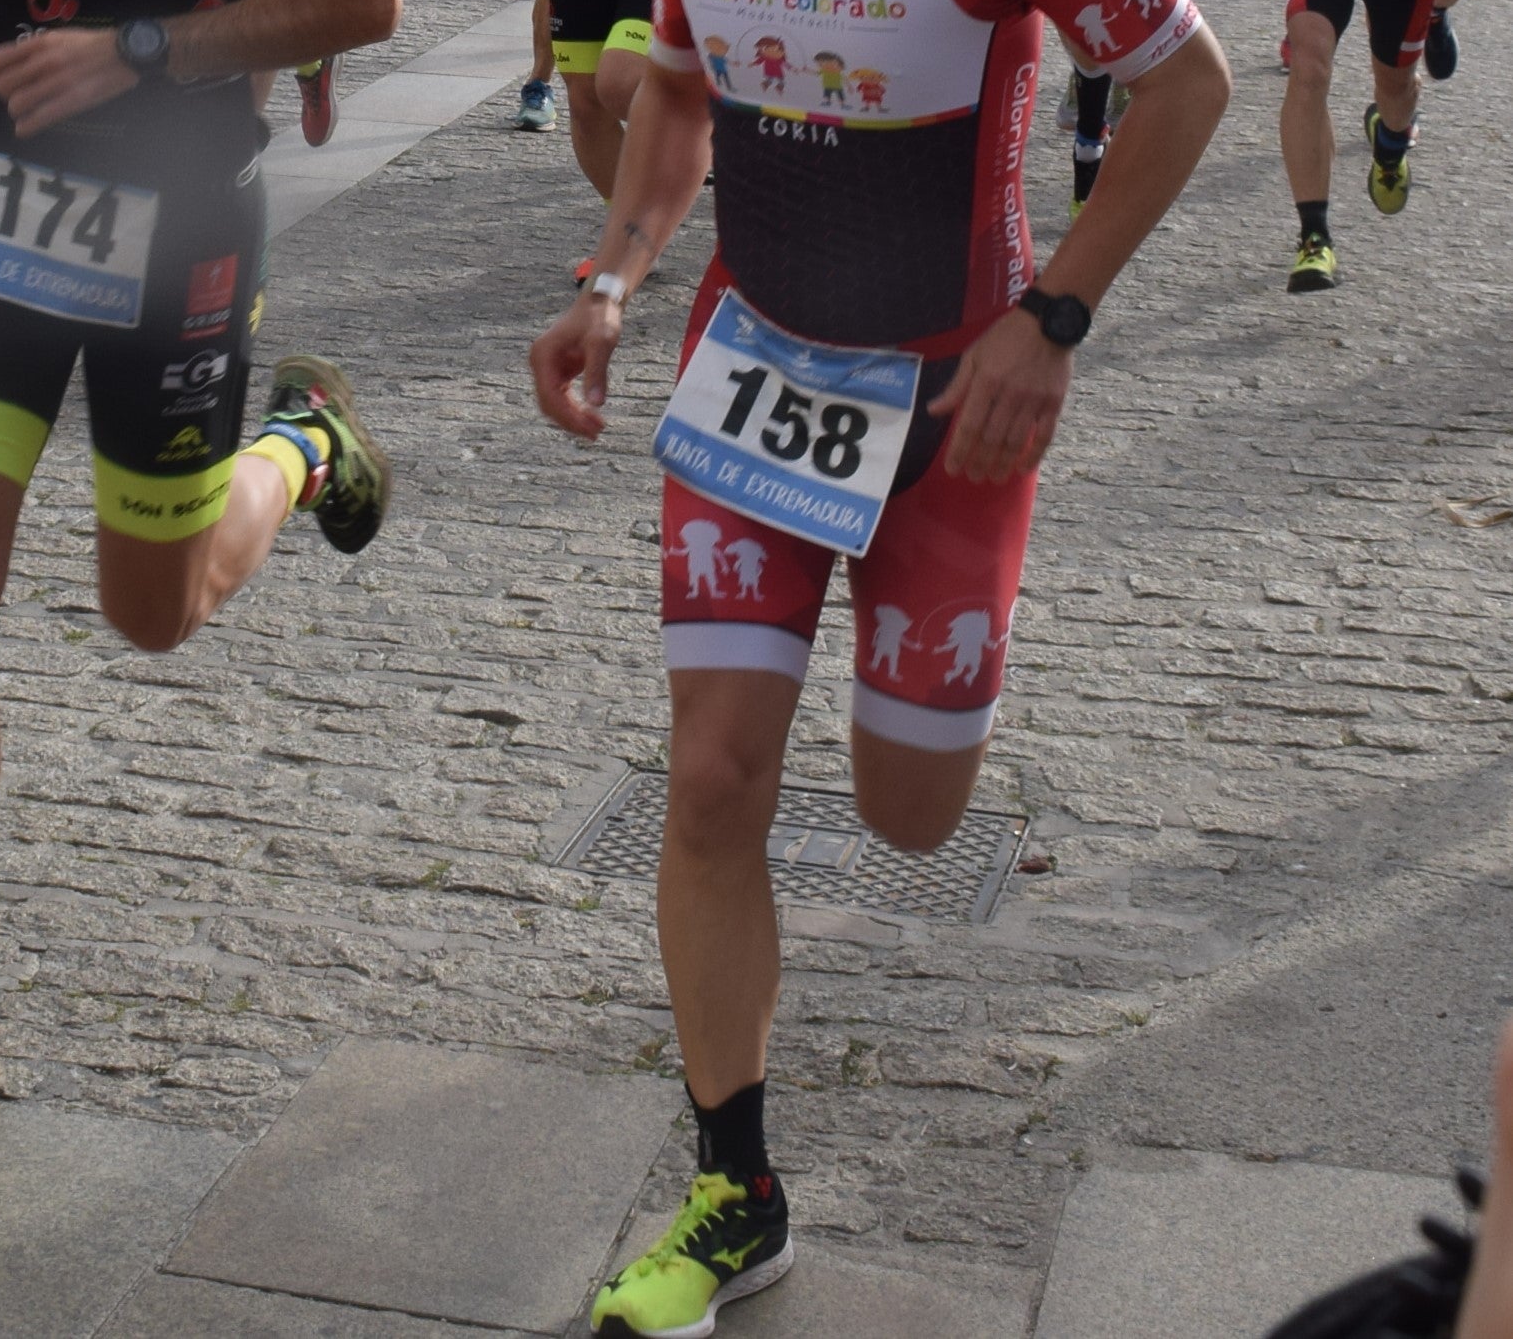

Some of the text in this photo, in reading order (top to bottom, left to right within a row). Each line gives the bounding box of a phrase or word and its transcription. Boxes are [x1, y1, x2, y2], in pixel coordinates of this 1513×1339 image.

[757, 116, 839, 148] CORIA
[718, 365, 870, 480] 158
[661, 433, 866, 536] JUNTA DE EXTREMADURA
